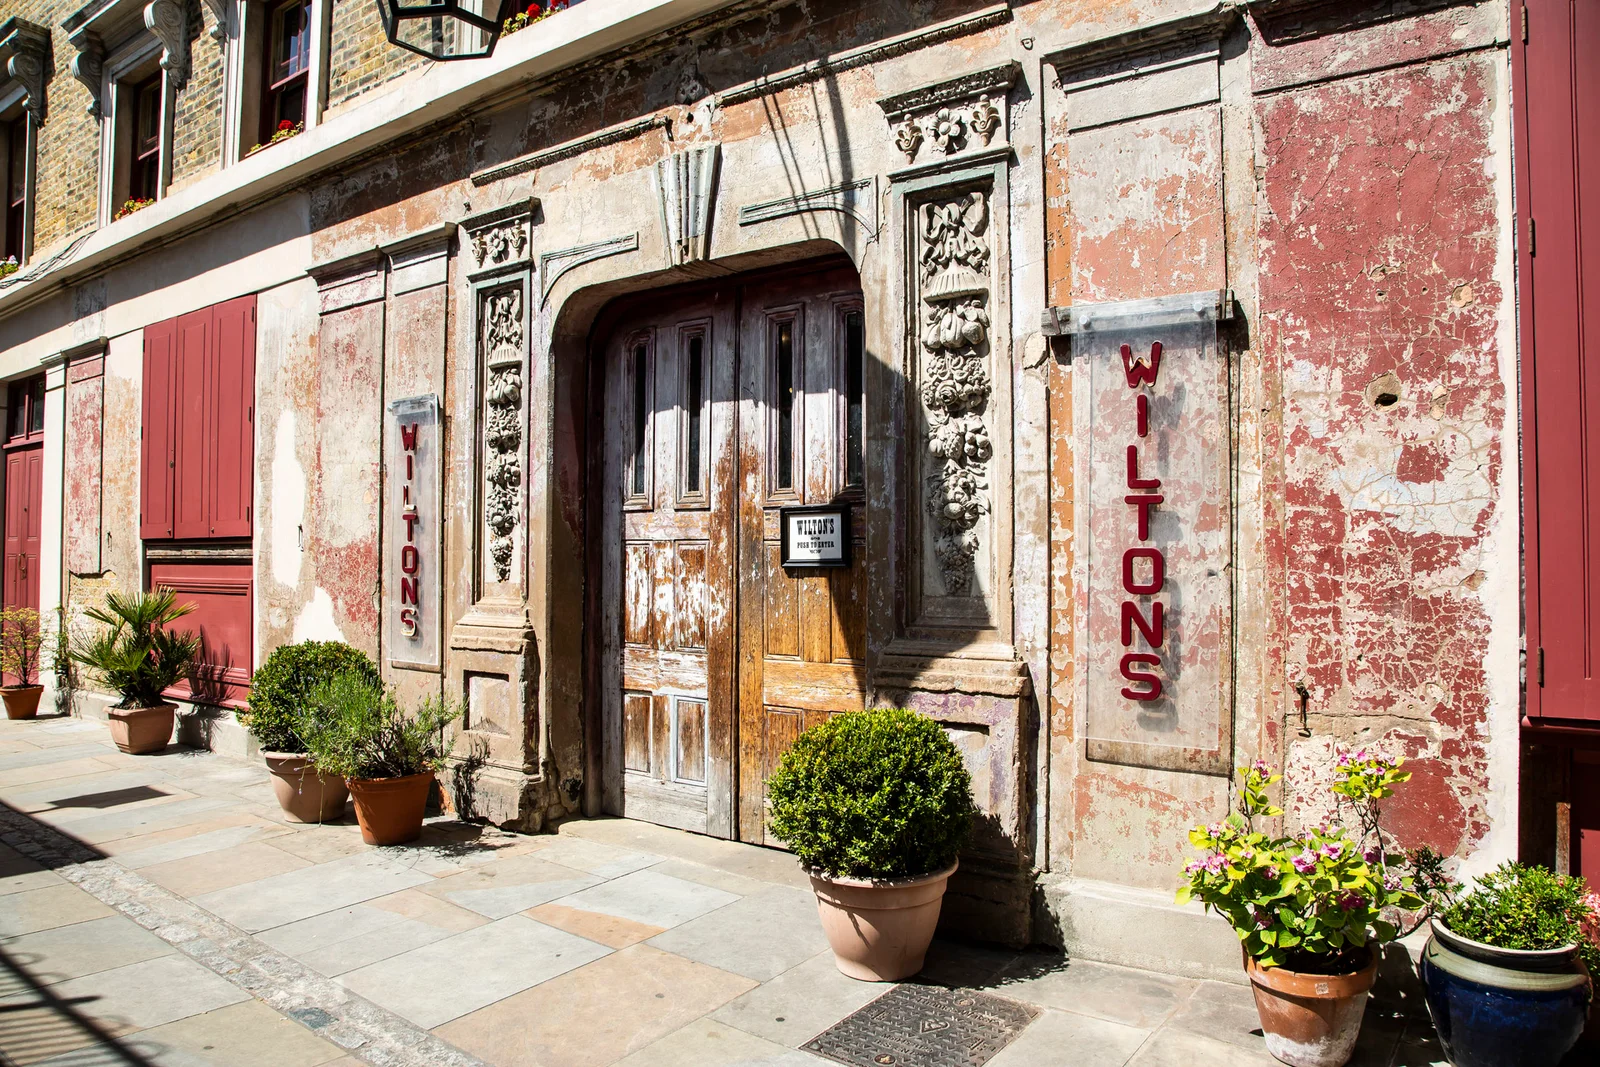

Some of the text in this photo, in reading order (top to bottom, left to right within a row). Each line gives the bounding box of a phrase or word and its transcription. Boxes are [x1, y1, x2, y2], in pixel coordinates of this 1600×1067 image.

[400, 423, 418, 636] WILTONS
[797, 518, 835, 535] WILTON'S
[1119, 340, 1164, 701] WILTONS
